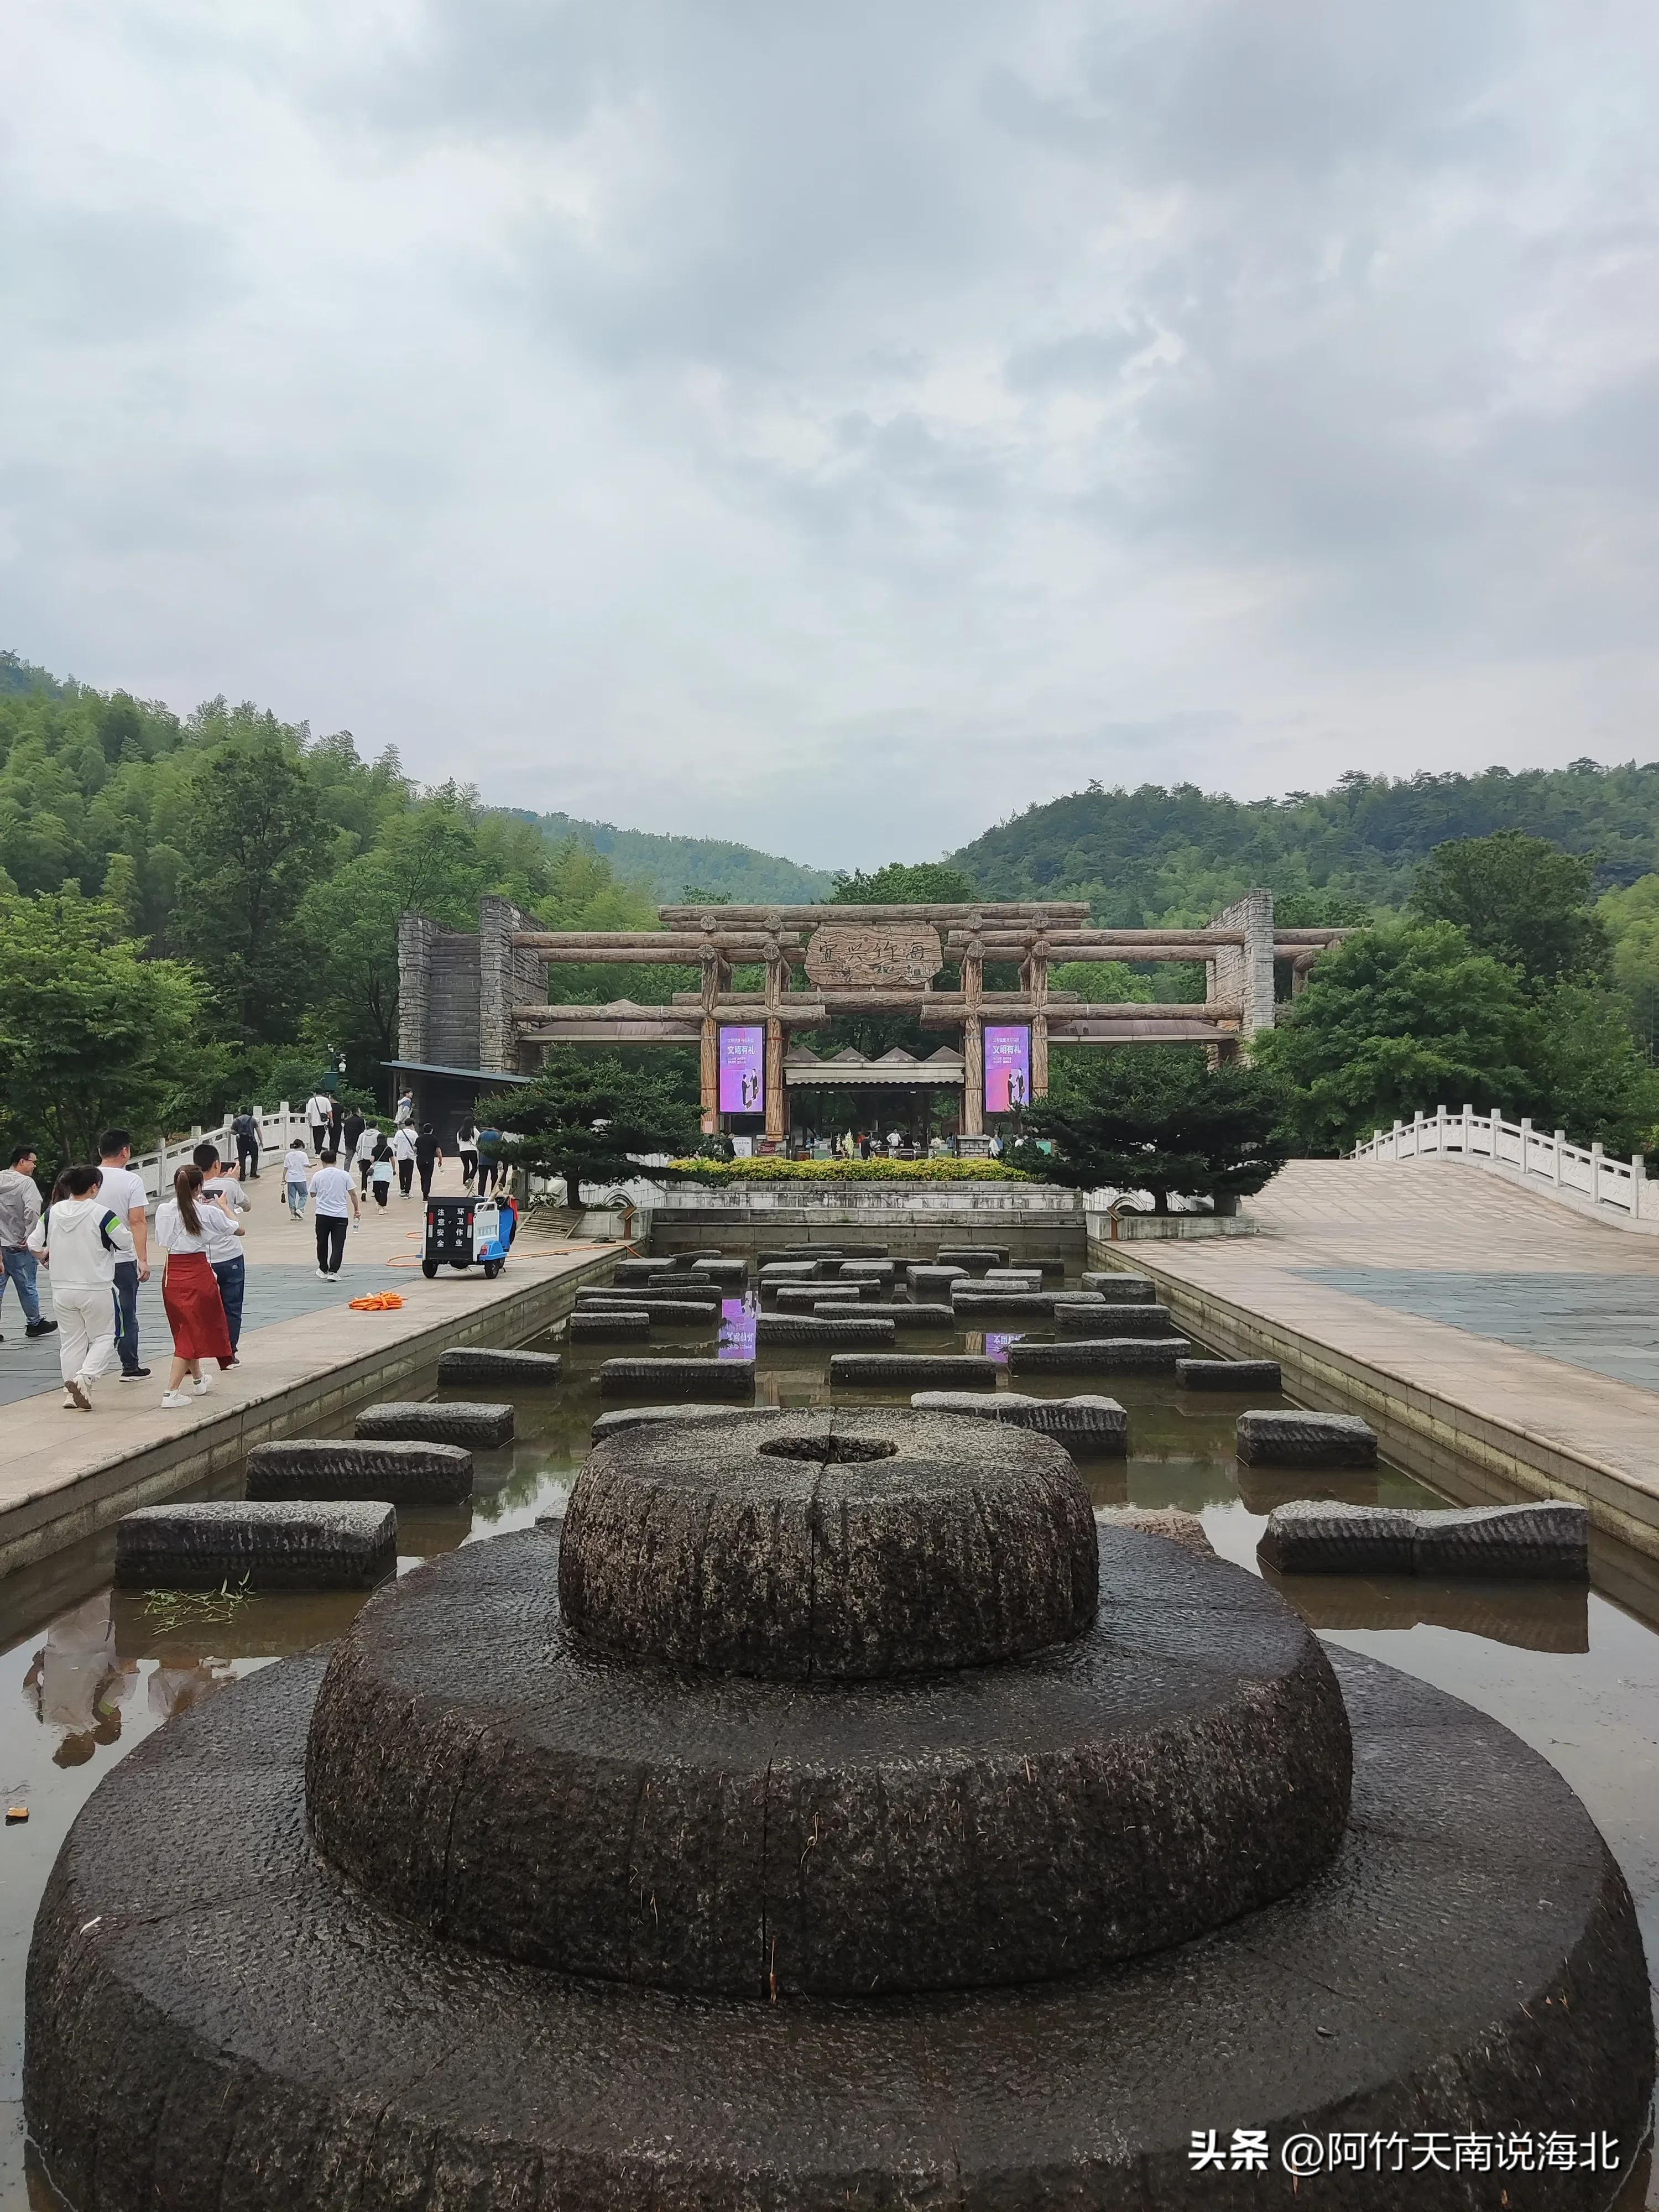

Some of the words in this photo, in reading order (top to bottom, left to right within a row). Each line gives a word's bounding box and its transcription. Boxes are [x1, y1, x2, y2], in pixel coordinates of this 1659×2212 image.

[818, 941, 931, 963] 宜兴竹海
[727, 1045, 755, 1055] 文明有礼
[993, 1045, 1021, 1054] 文明有礼
[437, 1209, 445, 1247] 注意安全
[455, 1208, 465, 1246] 环卫作业
